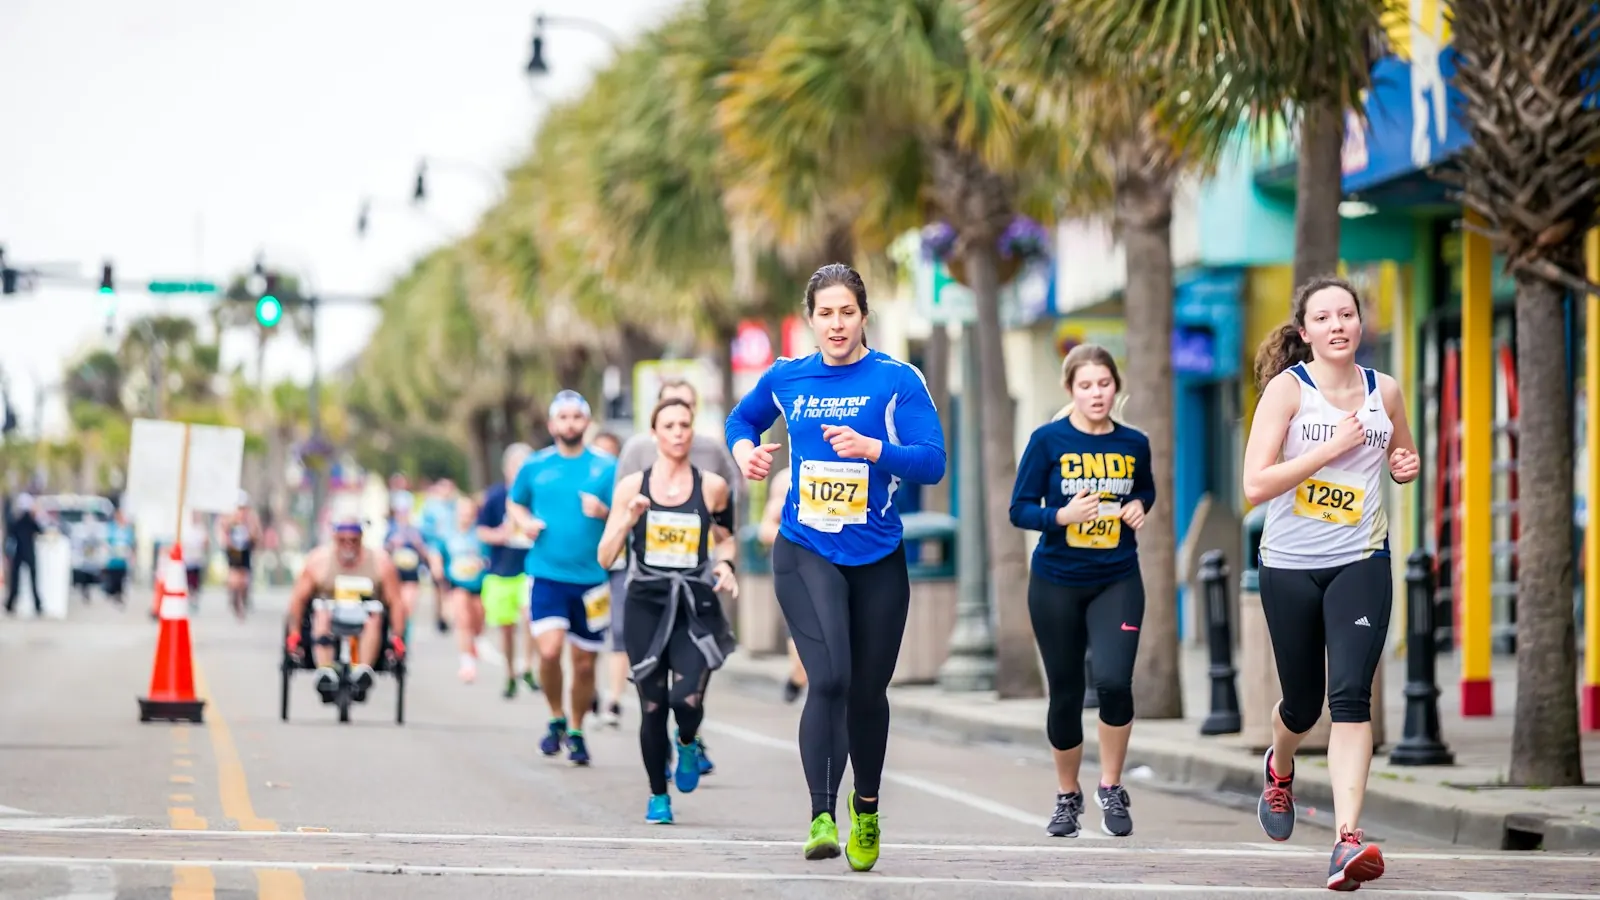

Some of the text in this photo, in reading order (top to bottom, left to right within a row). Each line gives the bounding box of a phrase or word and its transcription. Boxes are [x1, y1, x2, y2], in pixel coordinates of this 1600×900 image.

[807, 395, 870, 407] le coureur
[803, 407, 860, 420] nordique
[1363, 428, 1388, 449] AME
[809, 481, 858, 502] 1027
[1061, 478, 1097, 495] CROSS
[1307, 483, 1355, 511] 1292
[827, 507, 837, 515] 5K
[1322, 511, 1332, 520] 5K
[659, 528, 686, 543] 567
[1078, 519, 1114, 536] 1297
